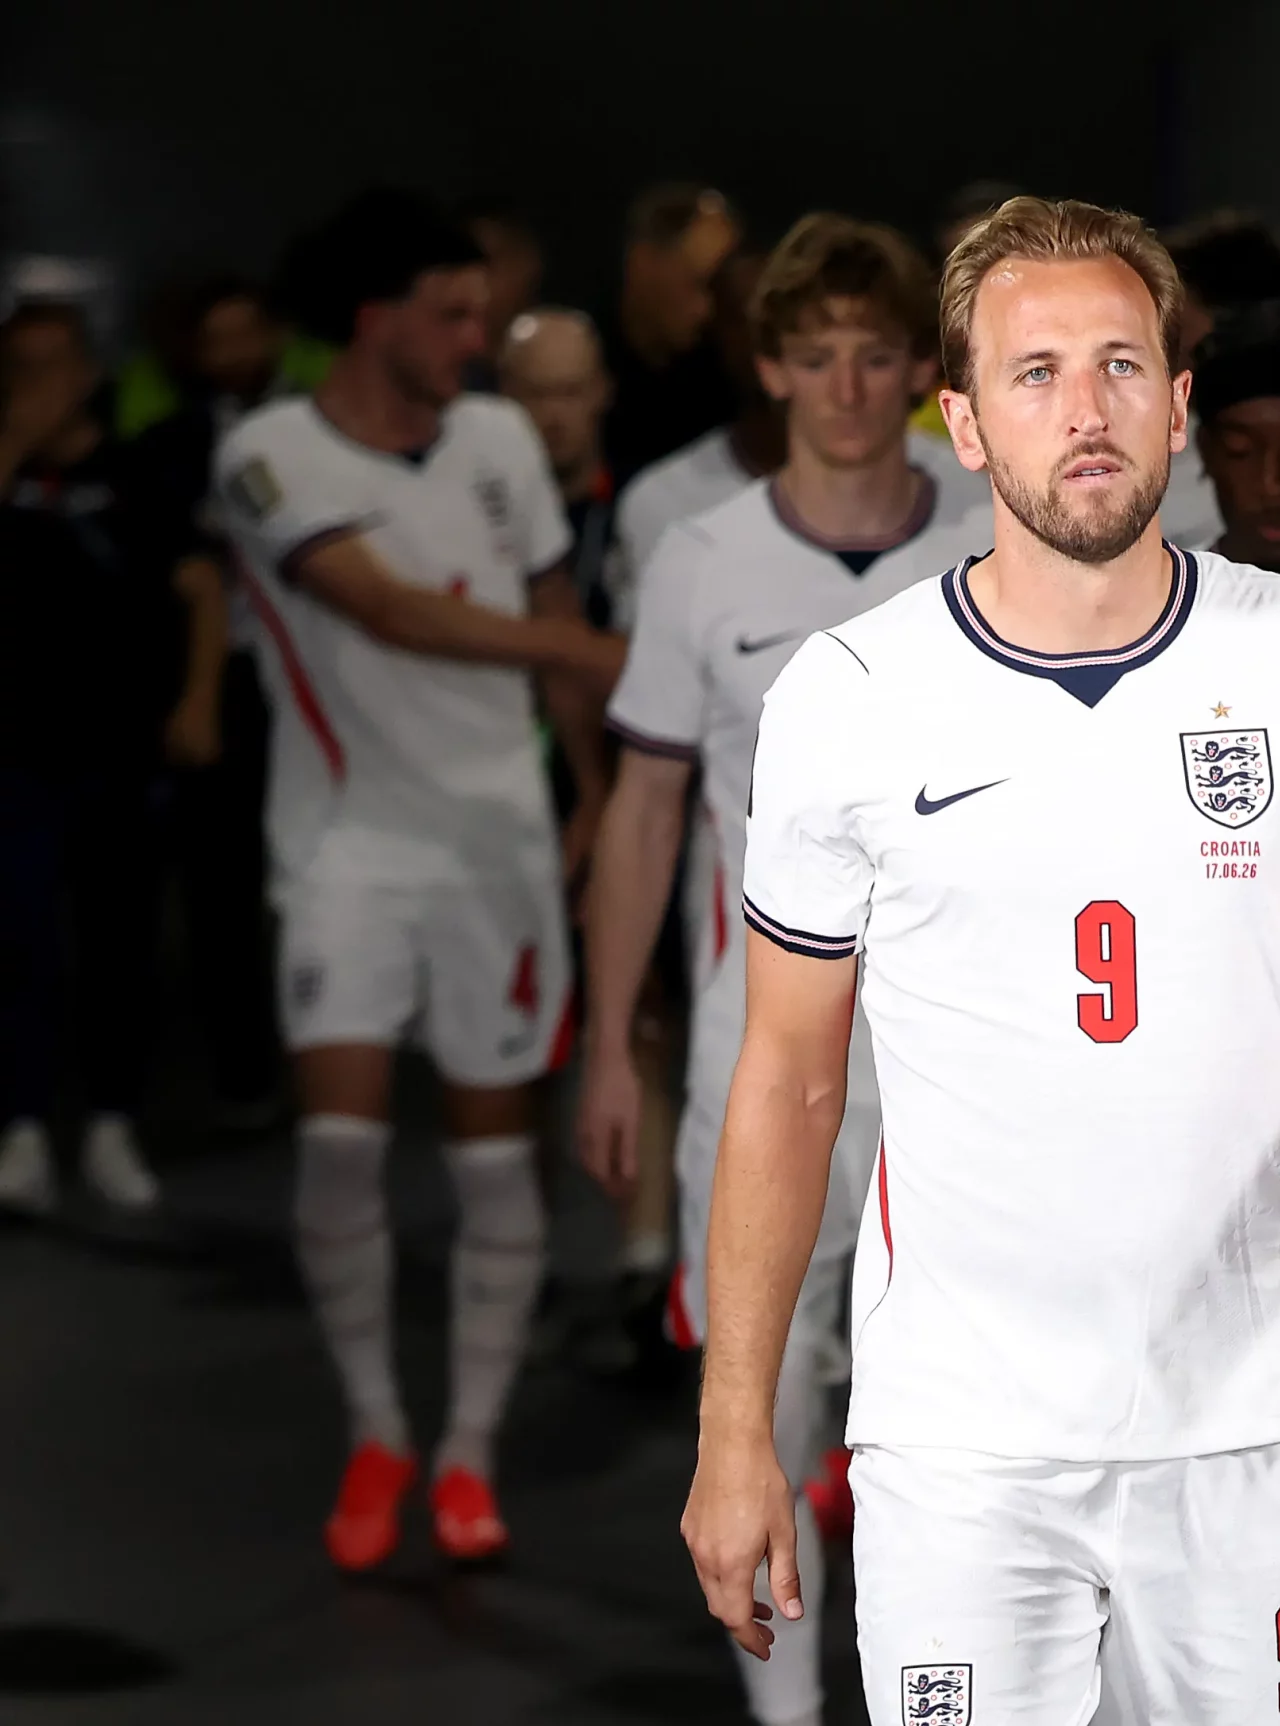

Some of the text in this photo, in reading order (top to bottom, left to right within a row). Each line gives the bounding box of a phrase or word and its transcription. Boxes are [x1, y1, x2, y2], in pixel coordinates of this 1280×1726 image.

[1200, 841, 1261, 857] CROATIA
[1205, 863, 1257, 879] 17.06.26
[1074, 899, 1138, 1043] 9
